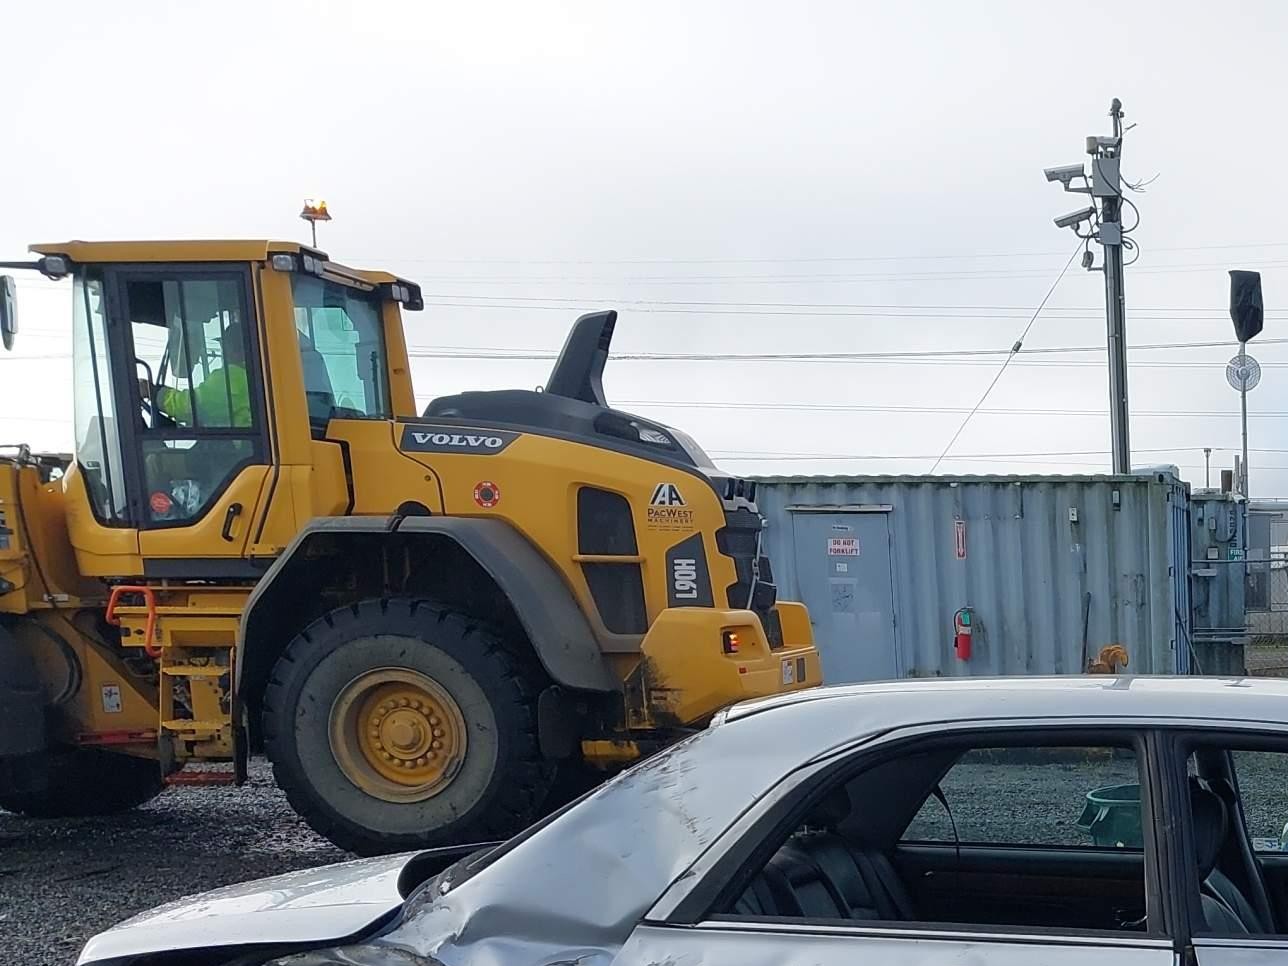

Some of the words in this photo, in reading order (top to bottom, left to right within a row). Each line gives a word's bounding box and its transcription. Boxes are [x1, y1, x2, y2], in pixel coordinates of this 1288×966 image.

[411, 432, 503, 448] VOLVO
[832, 539, 842, 547] DO
[843, 539, 855, 547] NOT
[829, 547, 859, 555] FORKLIFT
[673, 558, 698, 599] L90H
